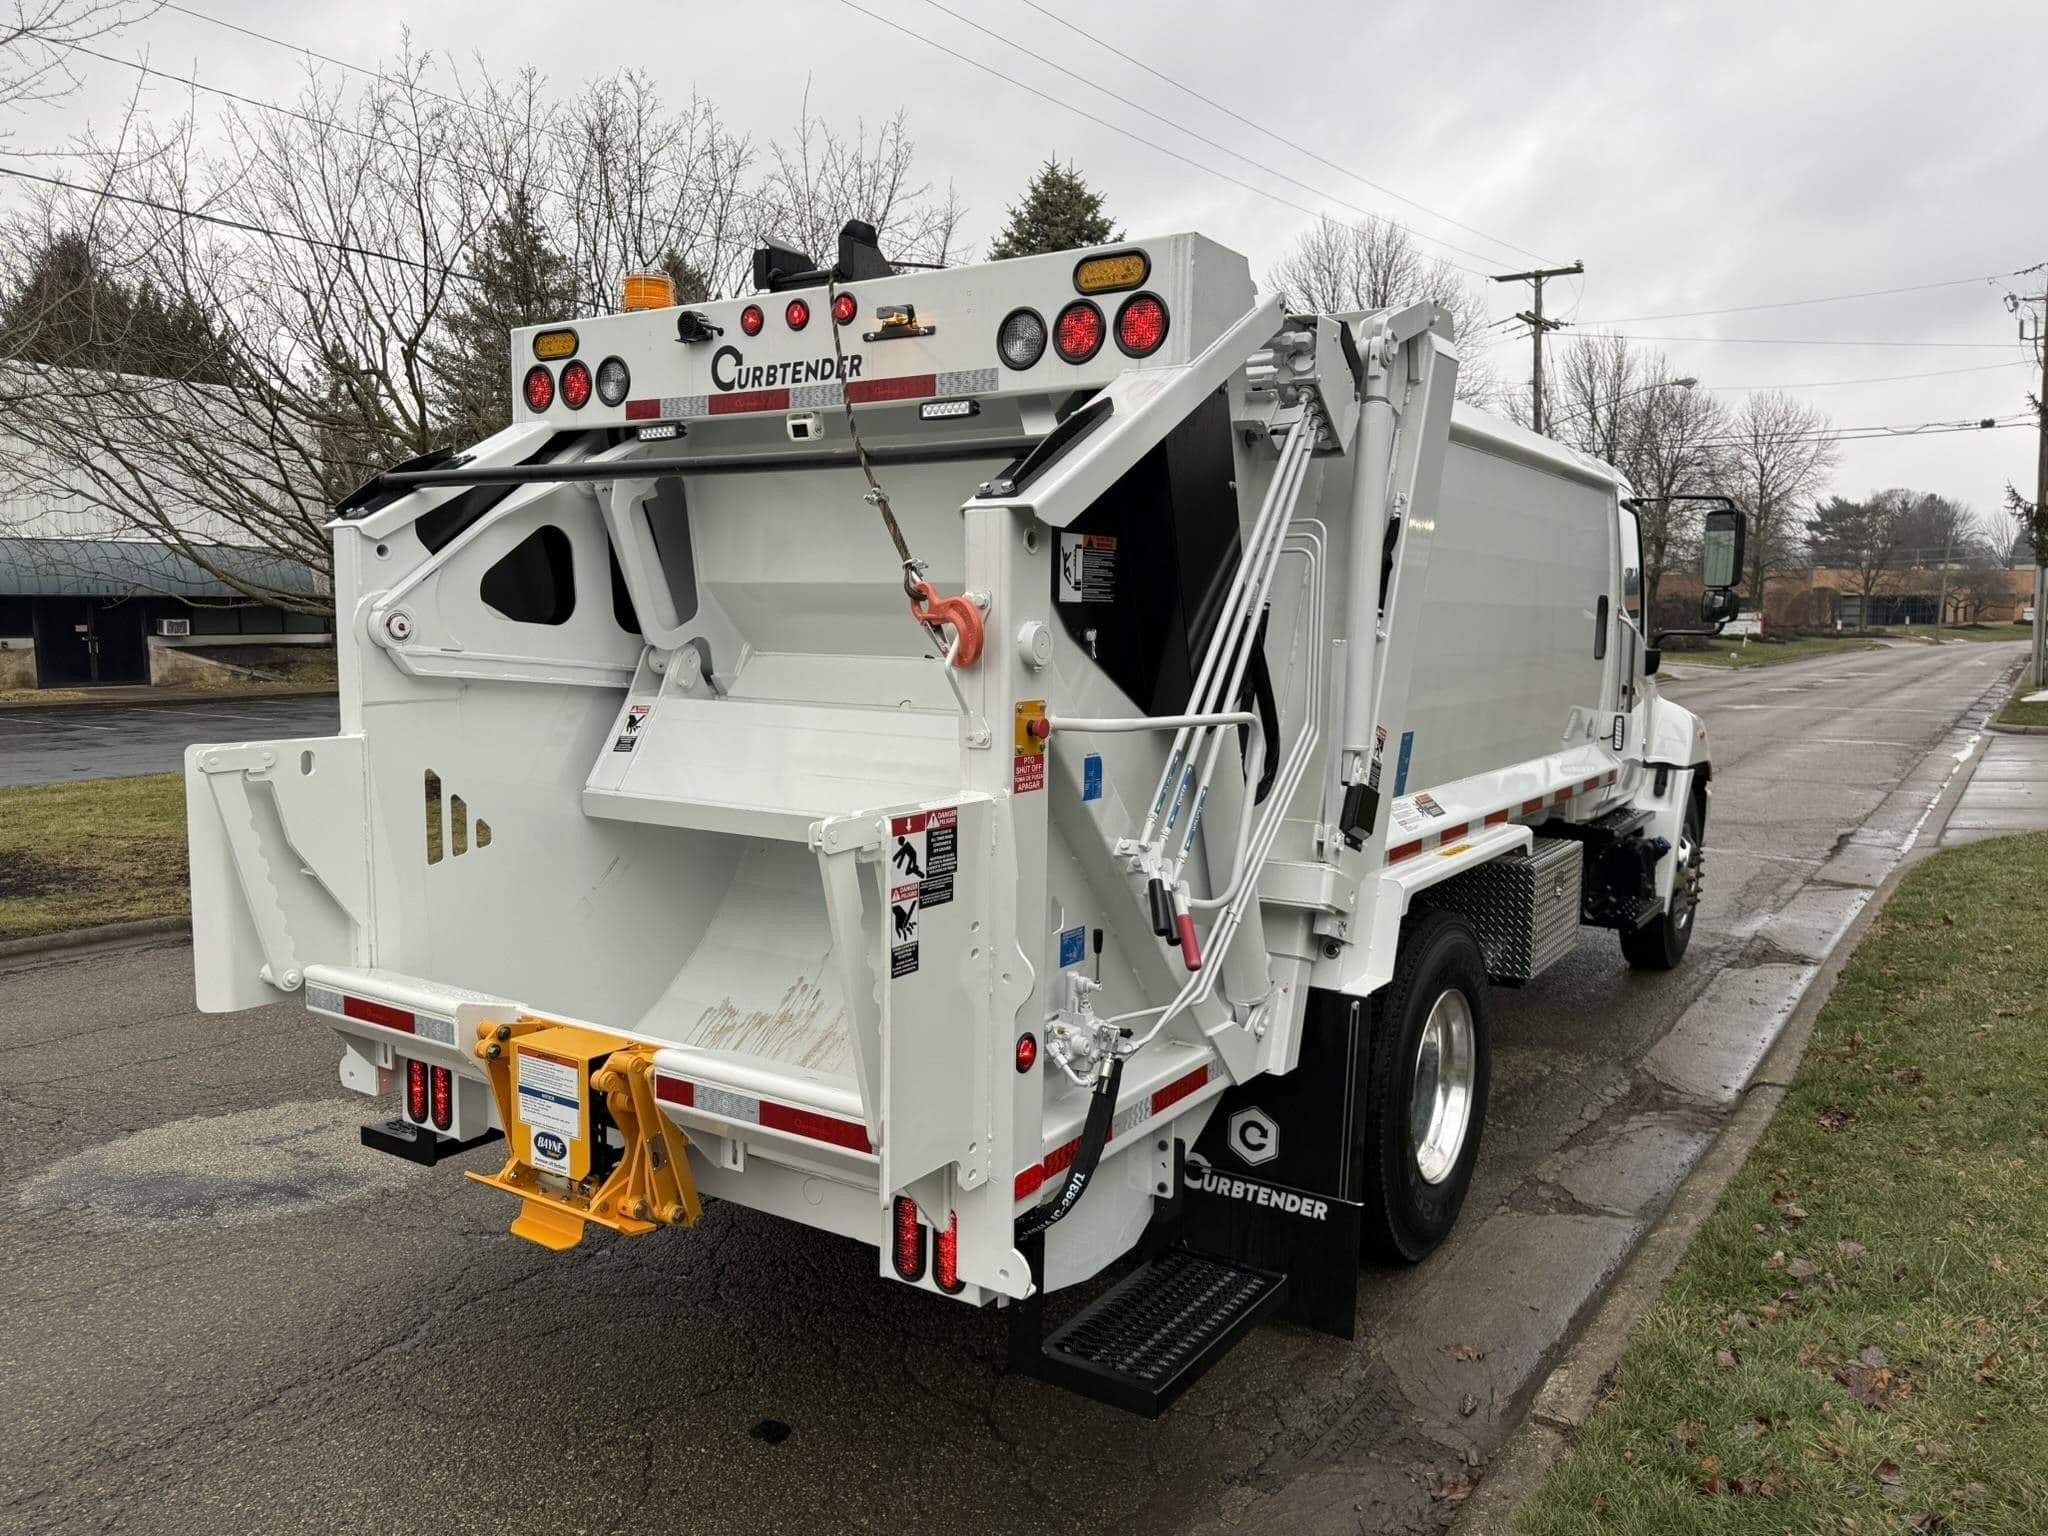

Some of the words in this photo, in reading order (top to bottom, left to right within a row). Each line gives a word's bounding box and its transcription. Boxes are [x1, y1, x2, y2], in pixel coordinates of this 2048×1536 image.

[711, 345, 863, 392] CURBTENDER
[1023, 756, 1035, 764] PTO
[1015, 765, 1031, 775] SHUT
[1031, 763, 1042, 772] OFF
[1017, 780, 1041, 792] APAGAR
[937, 809, 957, 819] DANGER
[900, 883, 918, 894] DANGER
[537, 1136, 563, 1153] BAYNE
[1183, 1151, 1329, 1221] CURBTENDER
